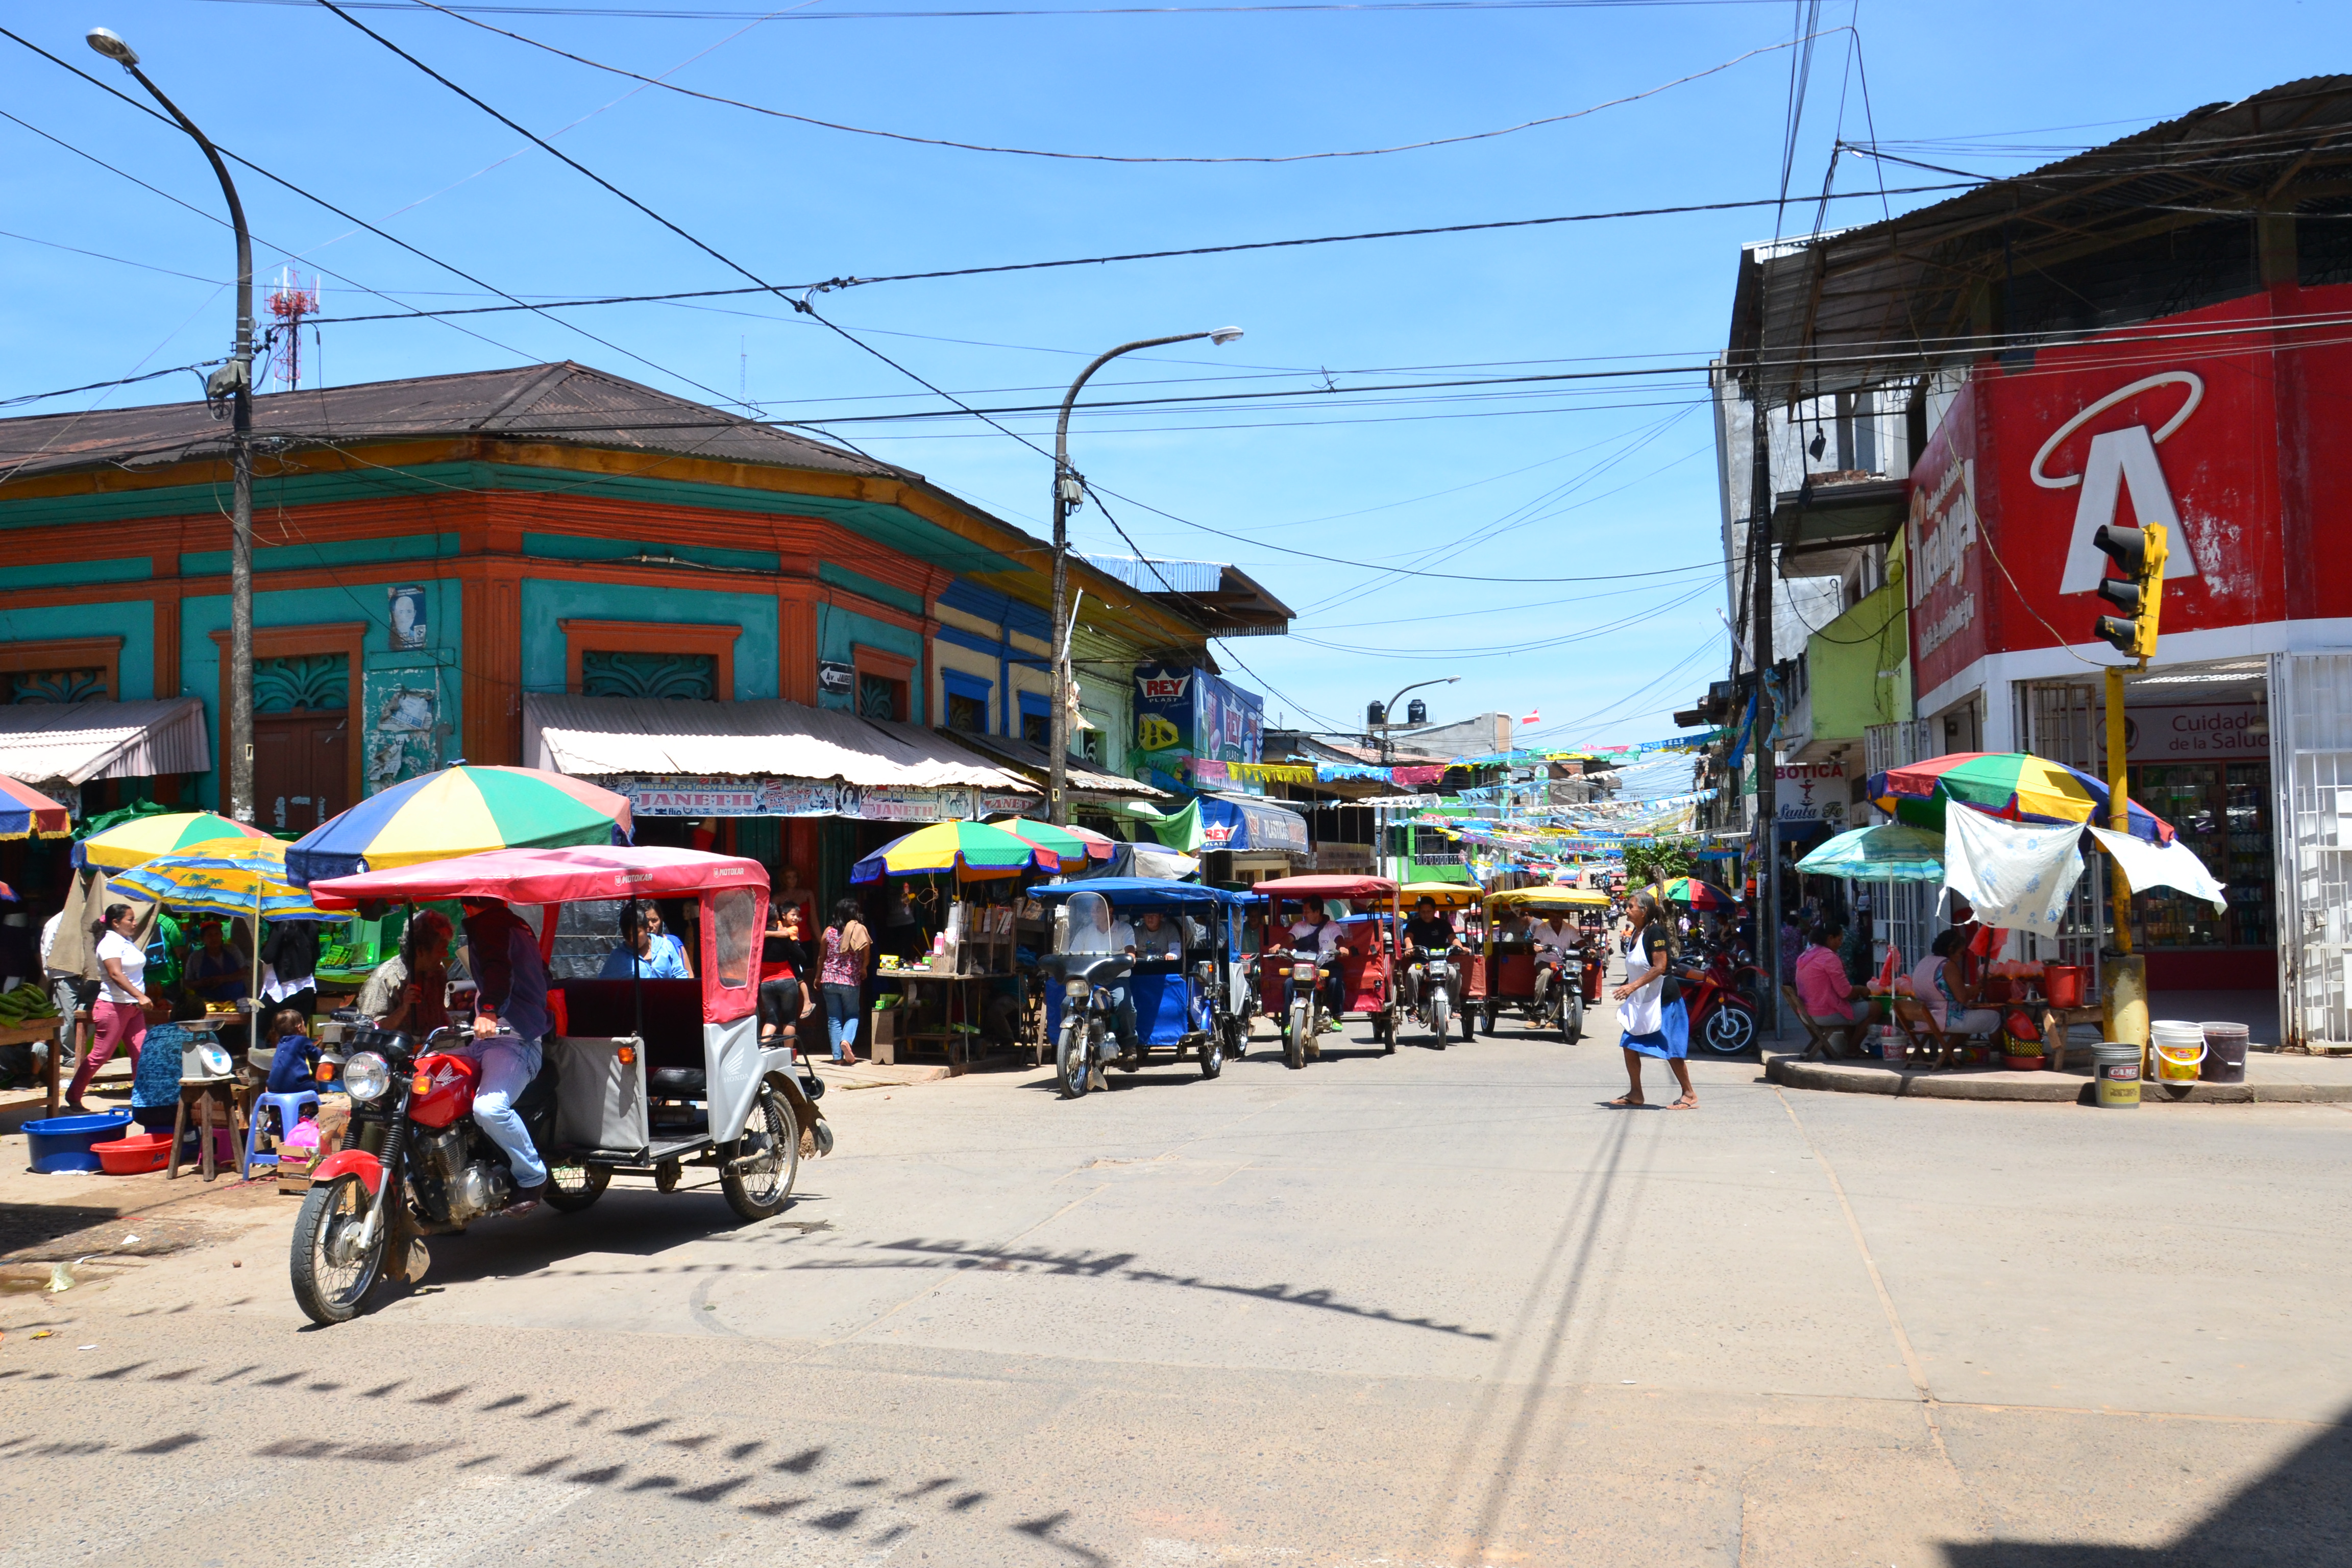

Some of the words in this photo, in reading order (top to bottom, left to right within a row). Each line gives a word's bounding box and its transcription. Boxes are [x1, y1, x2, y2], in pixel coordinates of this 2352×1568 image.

[1146, 680, 1183, 696] REY
[1226, 710, 1241, 746] REY
[2170, 738, 2189, 750] de
[2194, 737, 2206, 749] la
[1227, 750, 1239, 762] PLAST
[1775, 765, 1844, 779] BOTICA
[638, 793, 753, 806] JANETH
[871, 791, 892, 799] BAZAR
[893, 791, 902, 799] DE
[902, 792, 937, 801] NOVEDADES
[875, 805, 934, 816] JANETH
[1775, 803, 1817, 820] Santa
[1822, 801, 1844, 818] Fe
[1206, 829, 1231, 841] REY
[719, 868, 744, 876] MOTOKAR
[622, 873, 653, 884] MOTOKAR
[440, 1074, 463, 1087] HONDA
[724, 1073, 749, 1083] HONDA
